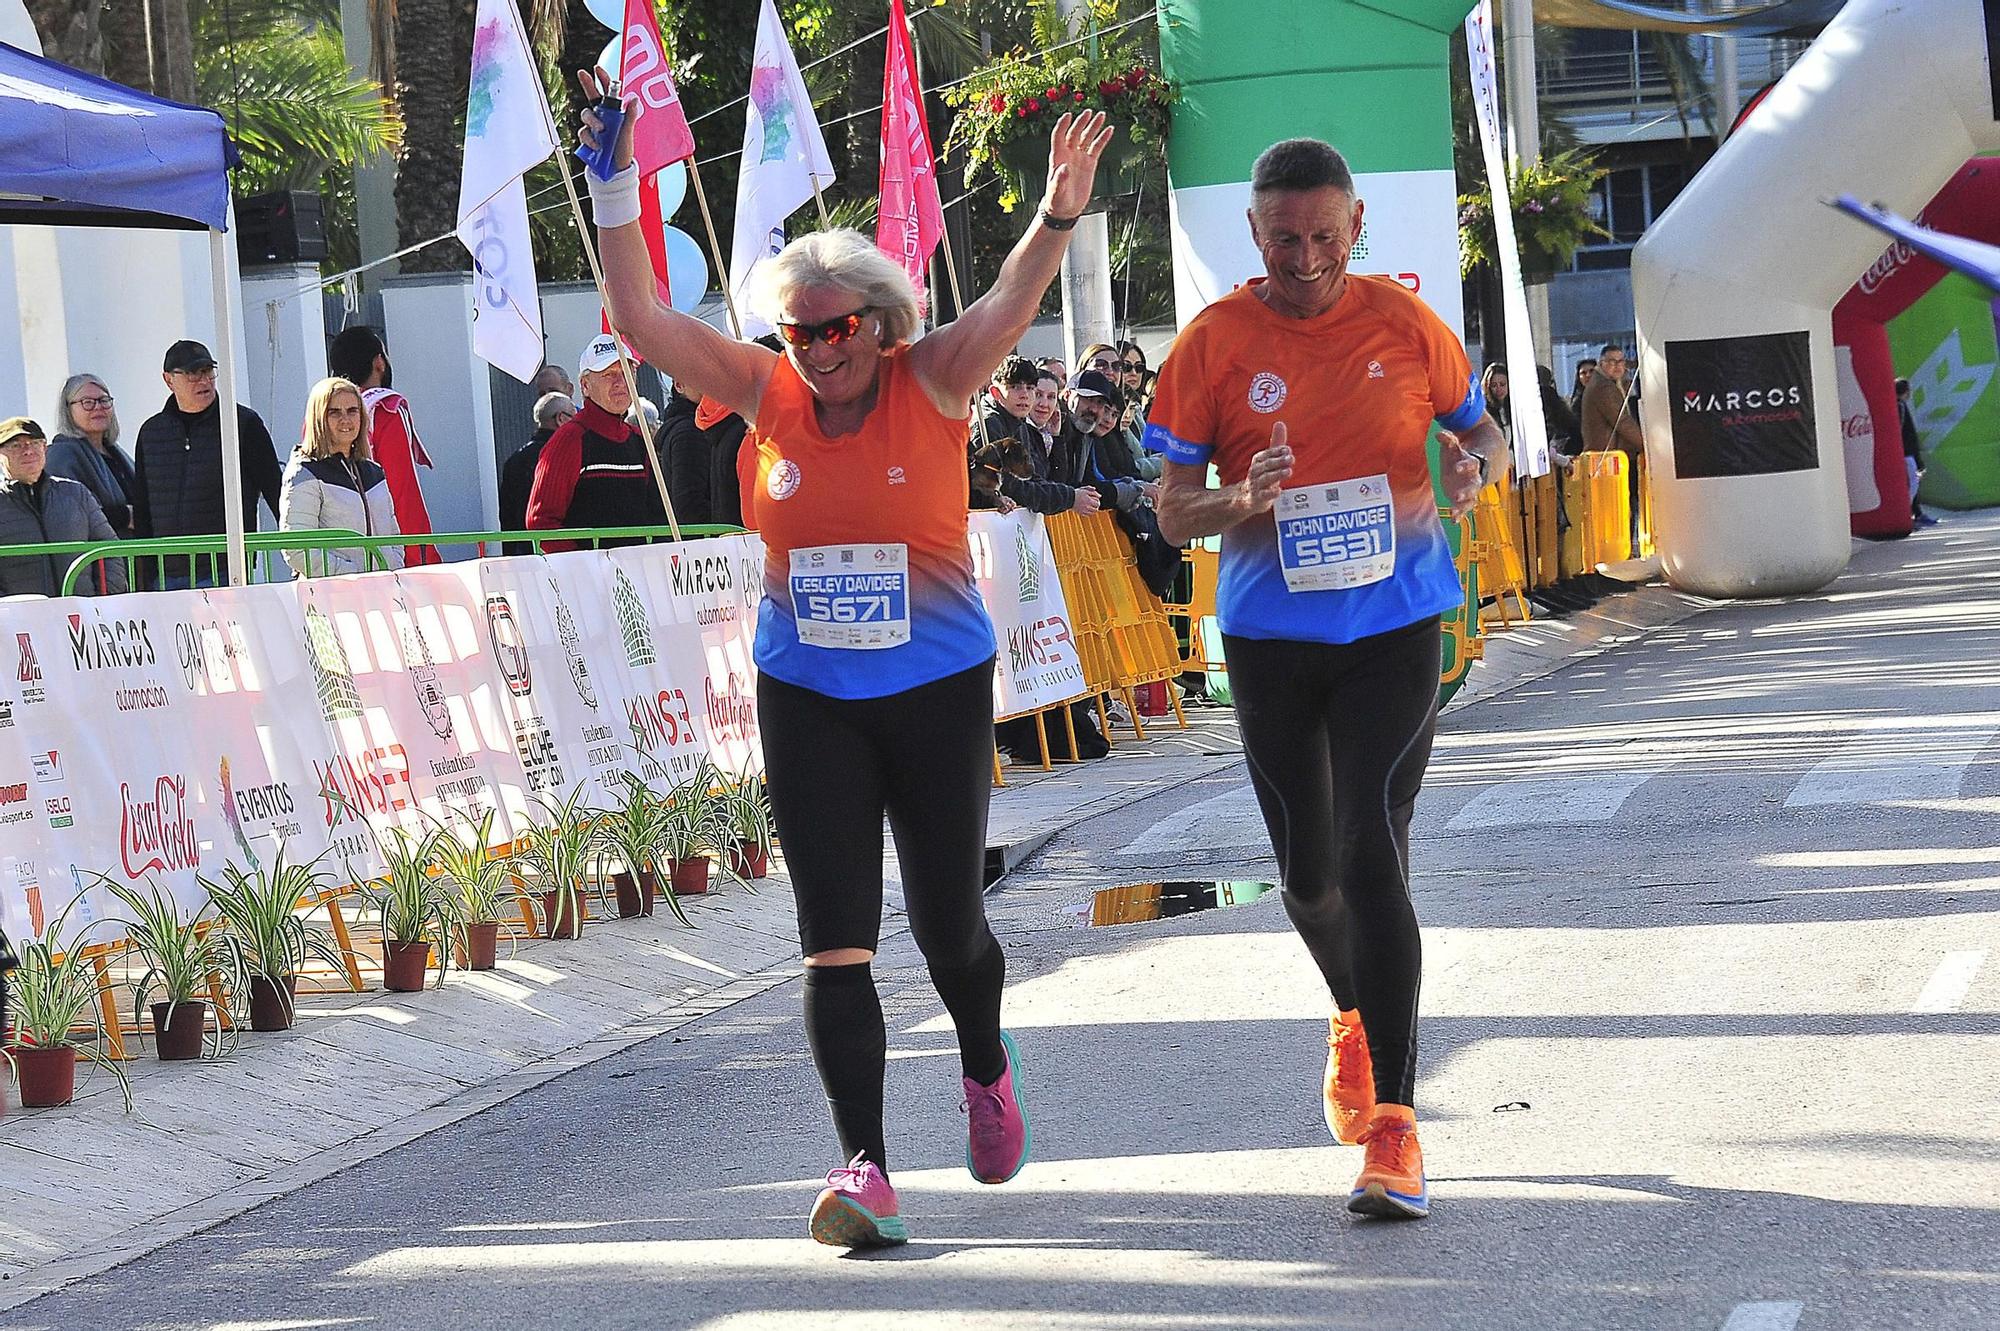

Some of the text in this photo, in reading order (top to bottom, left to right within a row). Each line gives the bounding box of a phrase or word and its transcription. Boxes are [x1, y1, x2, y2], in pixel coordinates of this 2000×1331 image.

[1684, 386, 1801, 413] MARCOS
[1285, 507, 1386, 538] JOHN DAVIDGE
[1295, 528, 1381, 567] 5531
[671, 555, 733, 597] MARCOS
[795, 574, 900, 593] LESLEY DAVIDGE
[808, 595, 891, 622] 5671
[67, 614, 156, 671] MARCOS
[115, 680, 170, 711] automoción
[516, 729, 558, 767] ELCHE
[235, 781, 294, 823] EVENTOS
